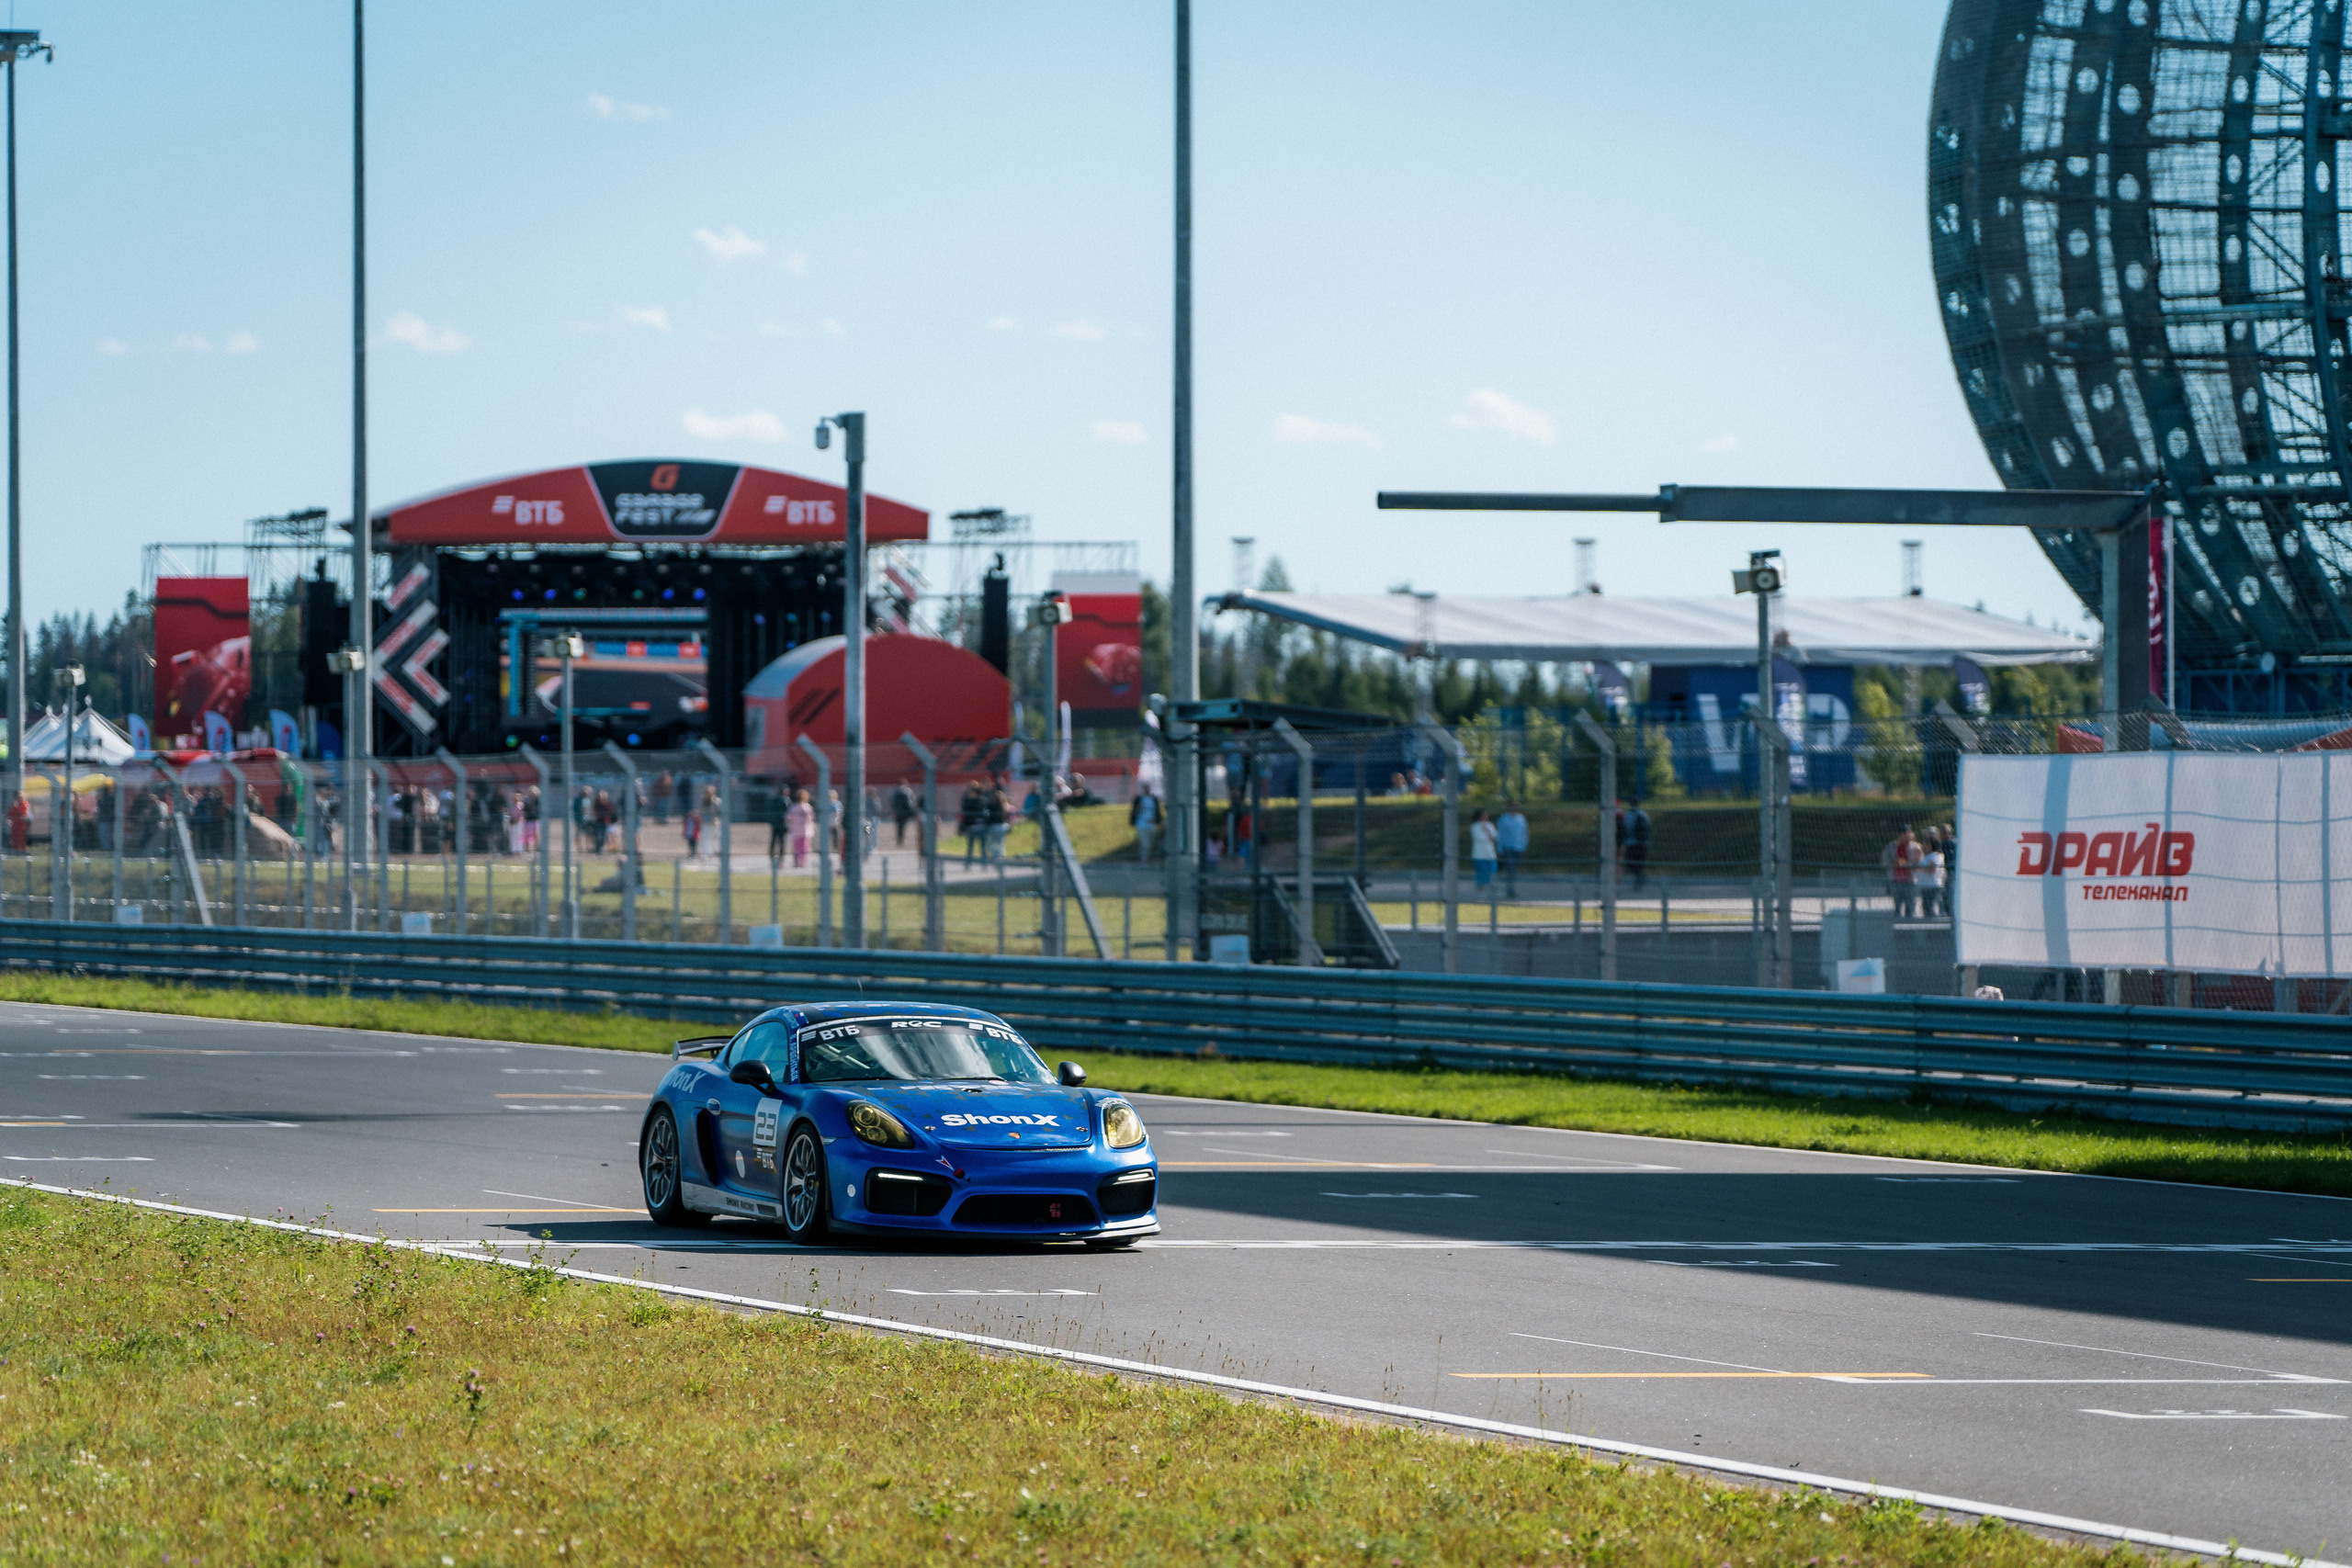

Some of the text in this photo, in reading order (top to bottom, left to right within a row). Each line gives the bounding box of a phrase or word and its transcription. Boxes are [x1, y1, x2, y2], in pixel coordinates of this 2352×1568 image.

[514, 500, 564, 525] ВТБ
[786, 500, 835, 525] ВТБ
[1697, 693, 1850, 771] VP
[2016, 822, 2196, 876] ДРАЙВ
[819, 1025, 860, 1041] ВТБ
[985, 1027, 1023, 1044] ВТБ
[755, 1111, 776, 1140] 23
[941, 1113, 1059, 1126] ShonX
